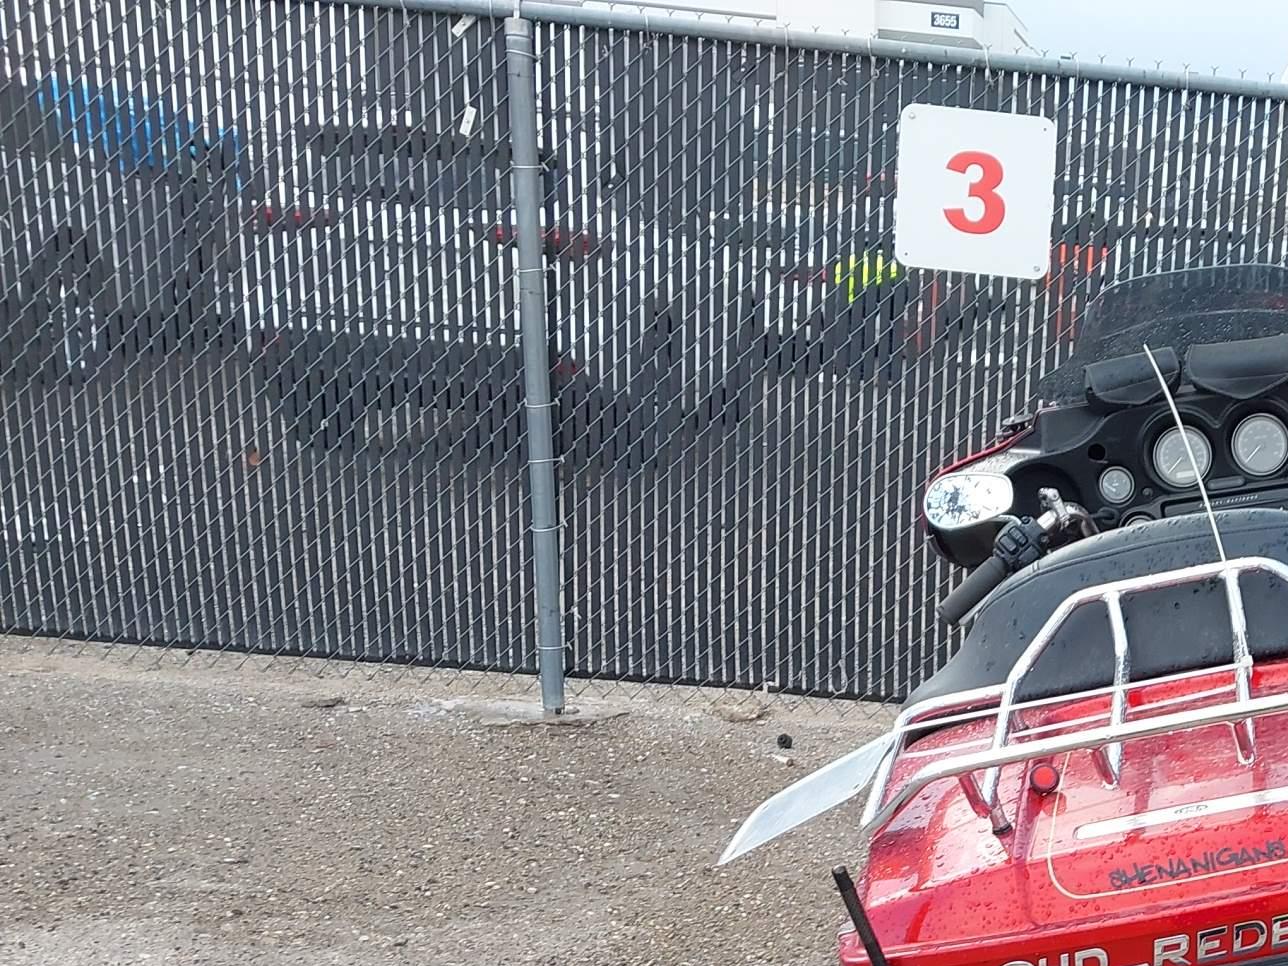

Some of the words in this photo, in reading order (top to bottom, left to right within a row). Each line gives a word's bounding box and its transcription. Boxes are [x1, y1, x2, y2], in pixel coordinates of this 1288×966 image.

[933, 14, 957, 27] 3655
[943, 151, 1006, 235] 3
[1109, 840, 1285, 888] SHENANIGANS
